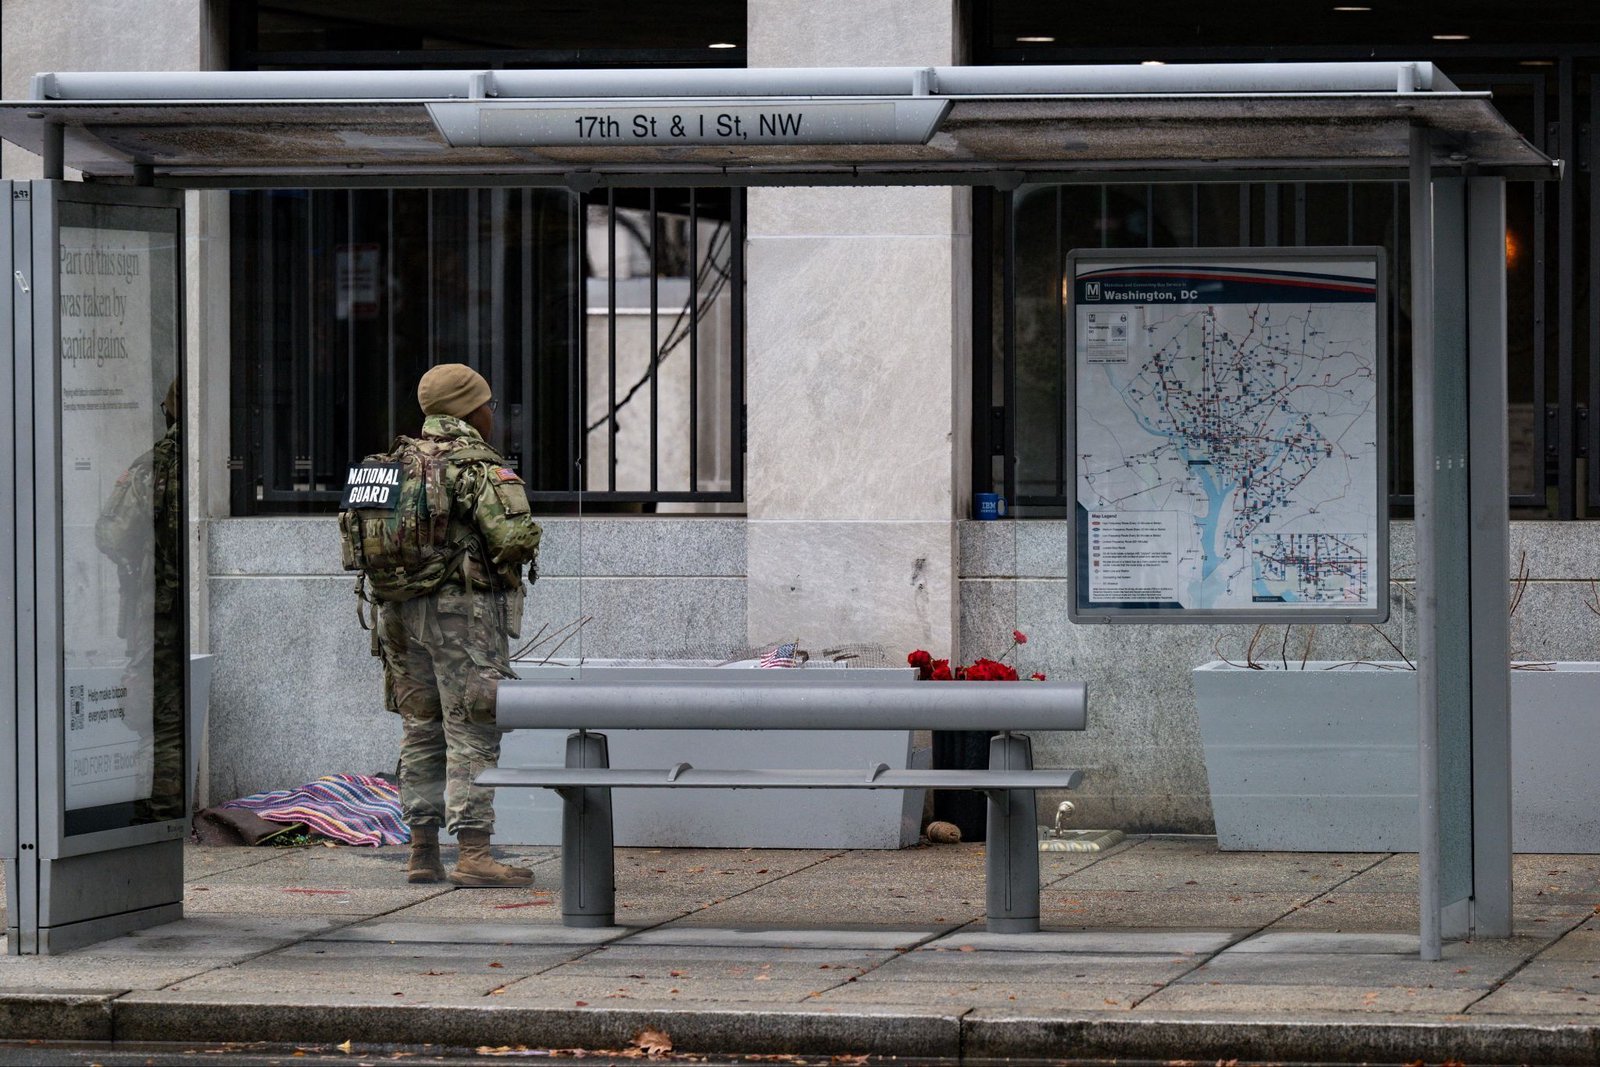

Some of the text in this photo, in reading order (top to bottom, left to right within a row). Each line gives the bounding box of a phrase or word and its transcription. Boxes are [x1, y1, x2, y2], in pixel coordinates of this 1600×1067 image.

[575, 113, 803, 139] 17th St & I St, NW
[60, 243, 139, 285] Part of this sign
[1104, 290, 1198, 301] Washington, DC
[60, 287, 127, 326] was taken by
[61, 327, 128, 368] capital gains.
[347, 467, 399, 486] NATIONAL
[348, 485, 390, 504] GUARD
[982, 501, 997, 509] IBM
[87, 689, 99, 704] Help
[88, 706, 108, 724] everyday
